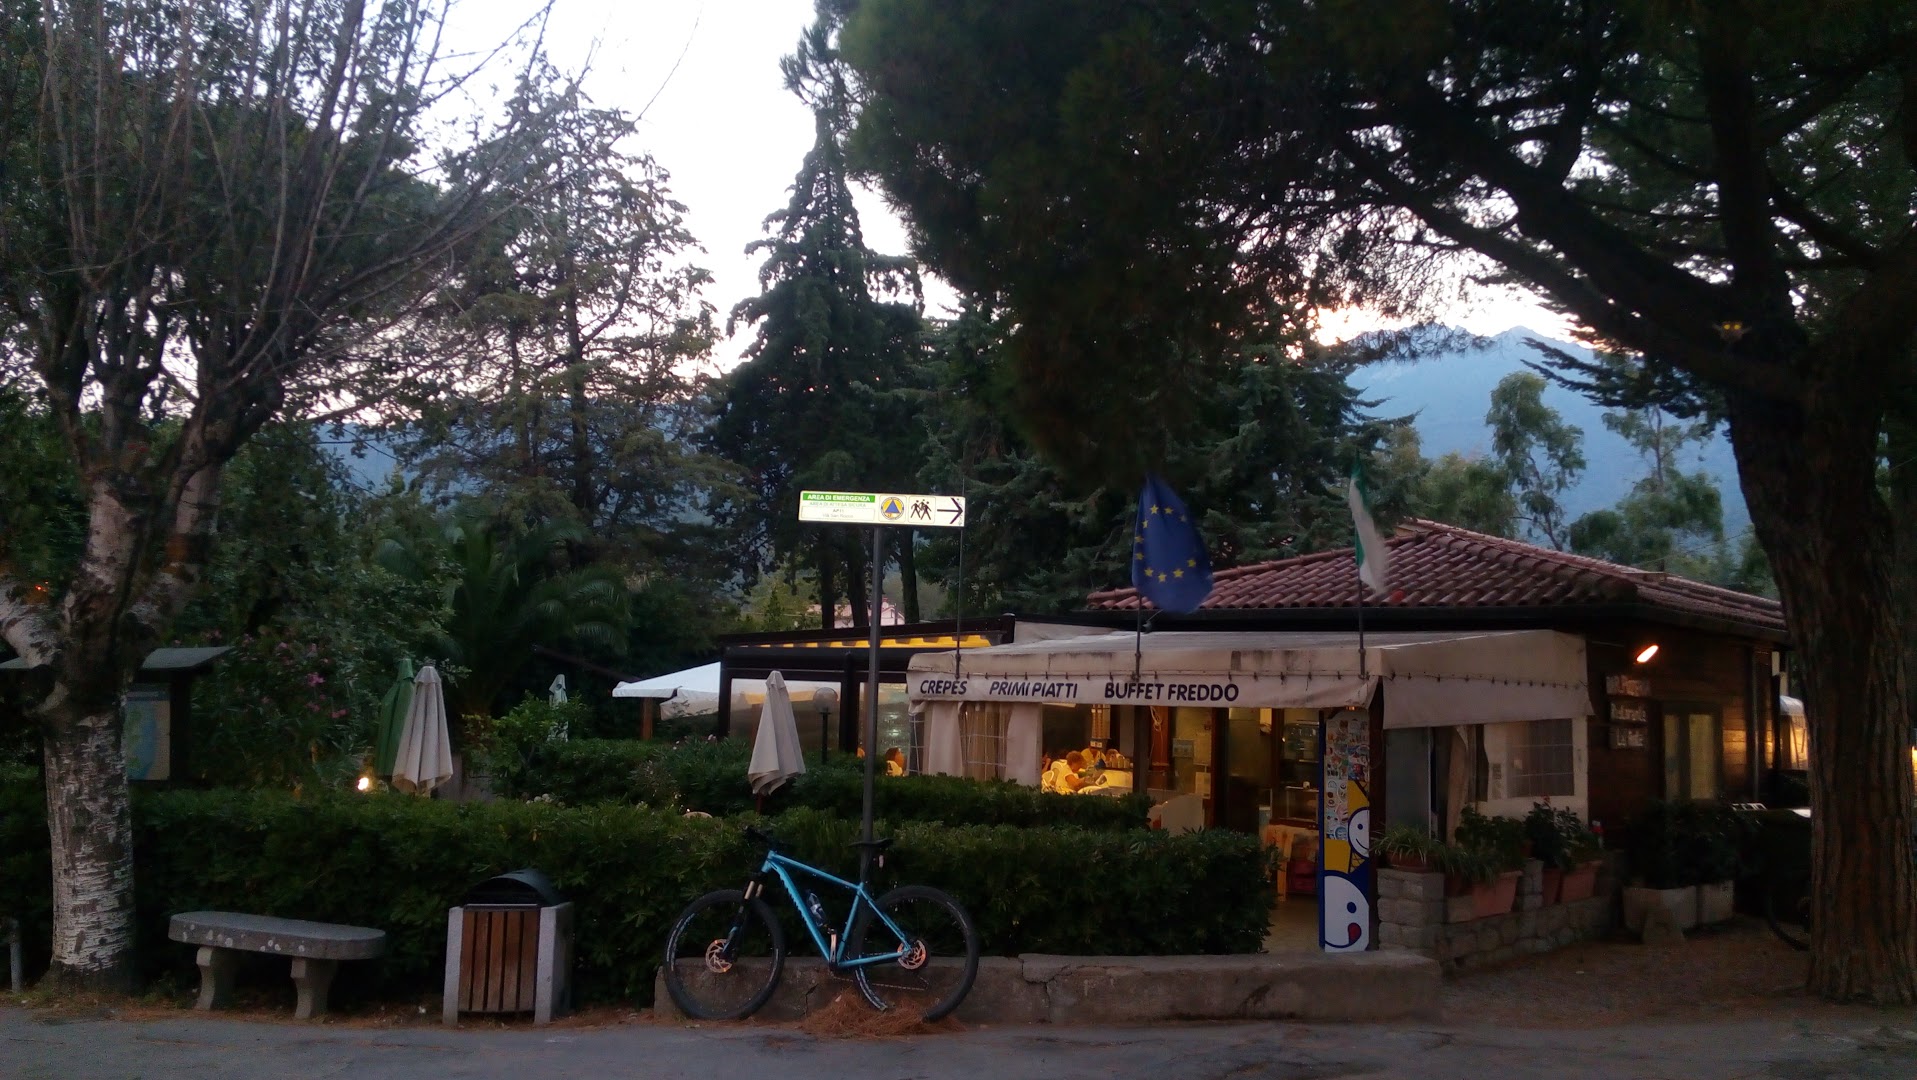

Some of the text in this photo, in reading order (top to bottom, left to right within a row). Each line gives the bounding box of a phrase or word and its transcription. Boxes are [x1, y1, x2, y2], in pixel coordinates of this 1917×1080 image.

[920, 680, 1239, 701] CREPES PRIMI PIATTI BUFFET FREDDO
